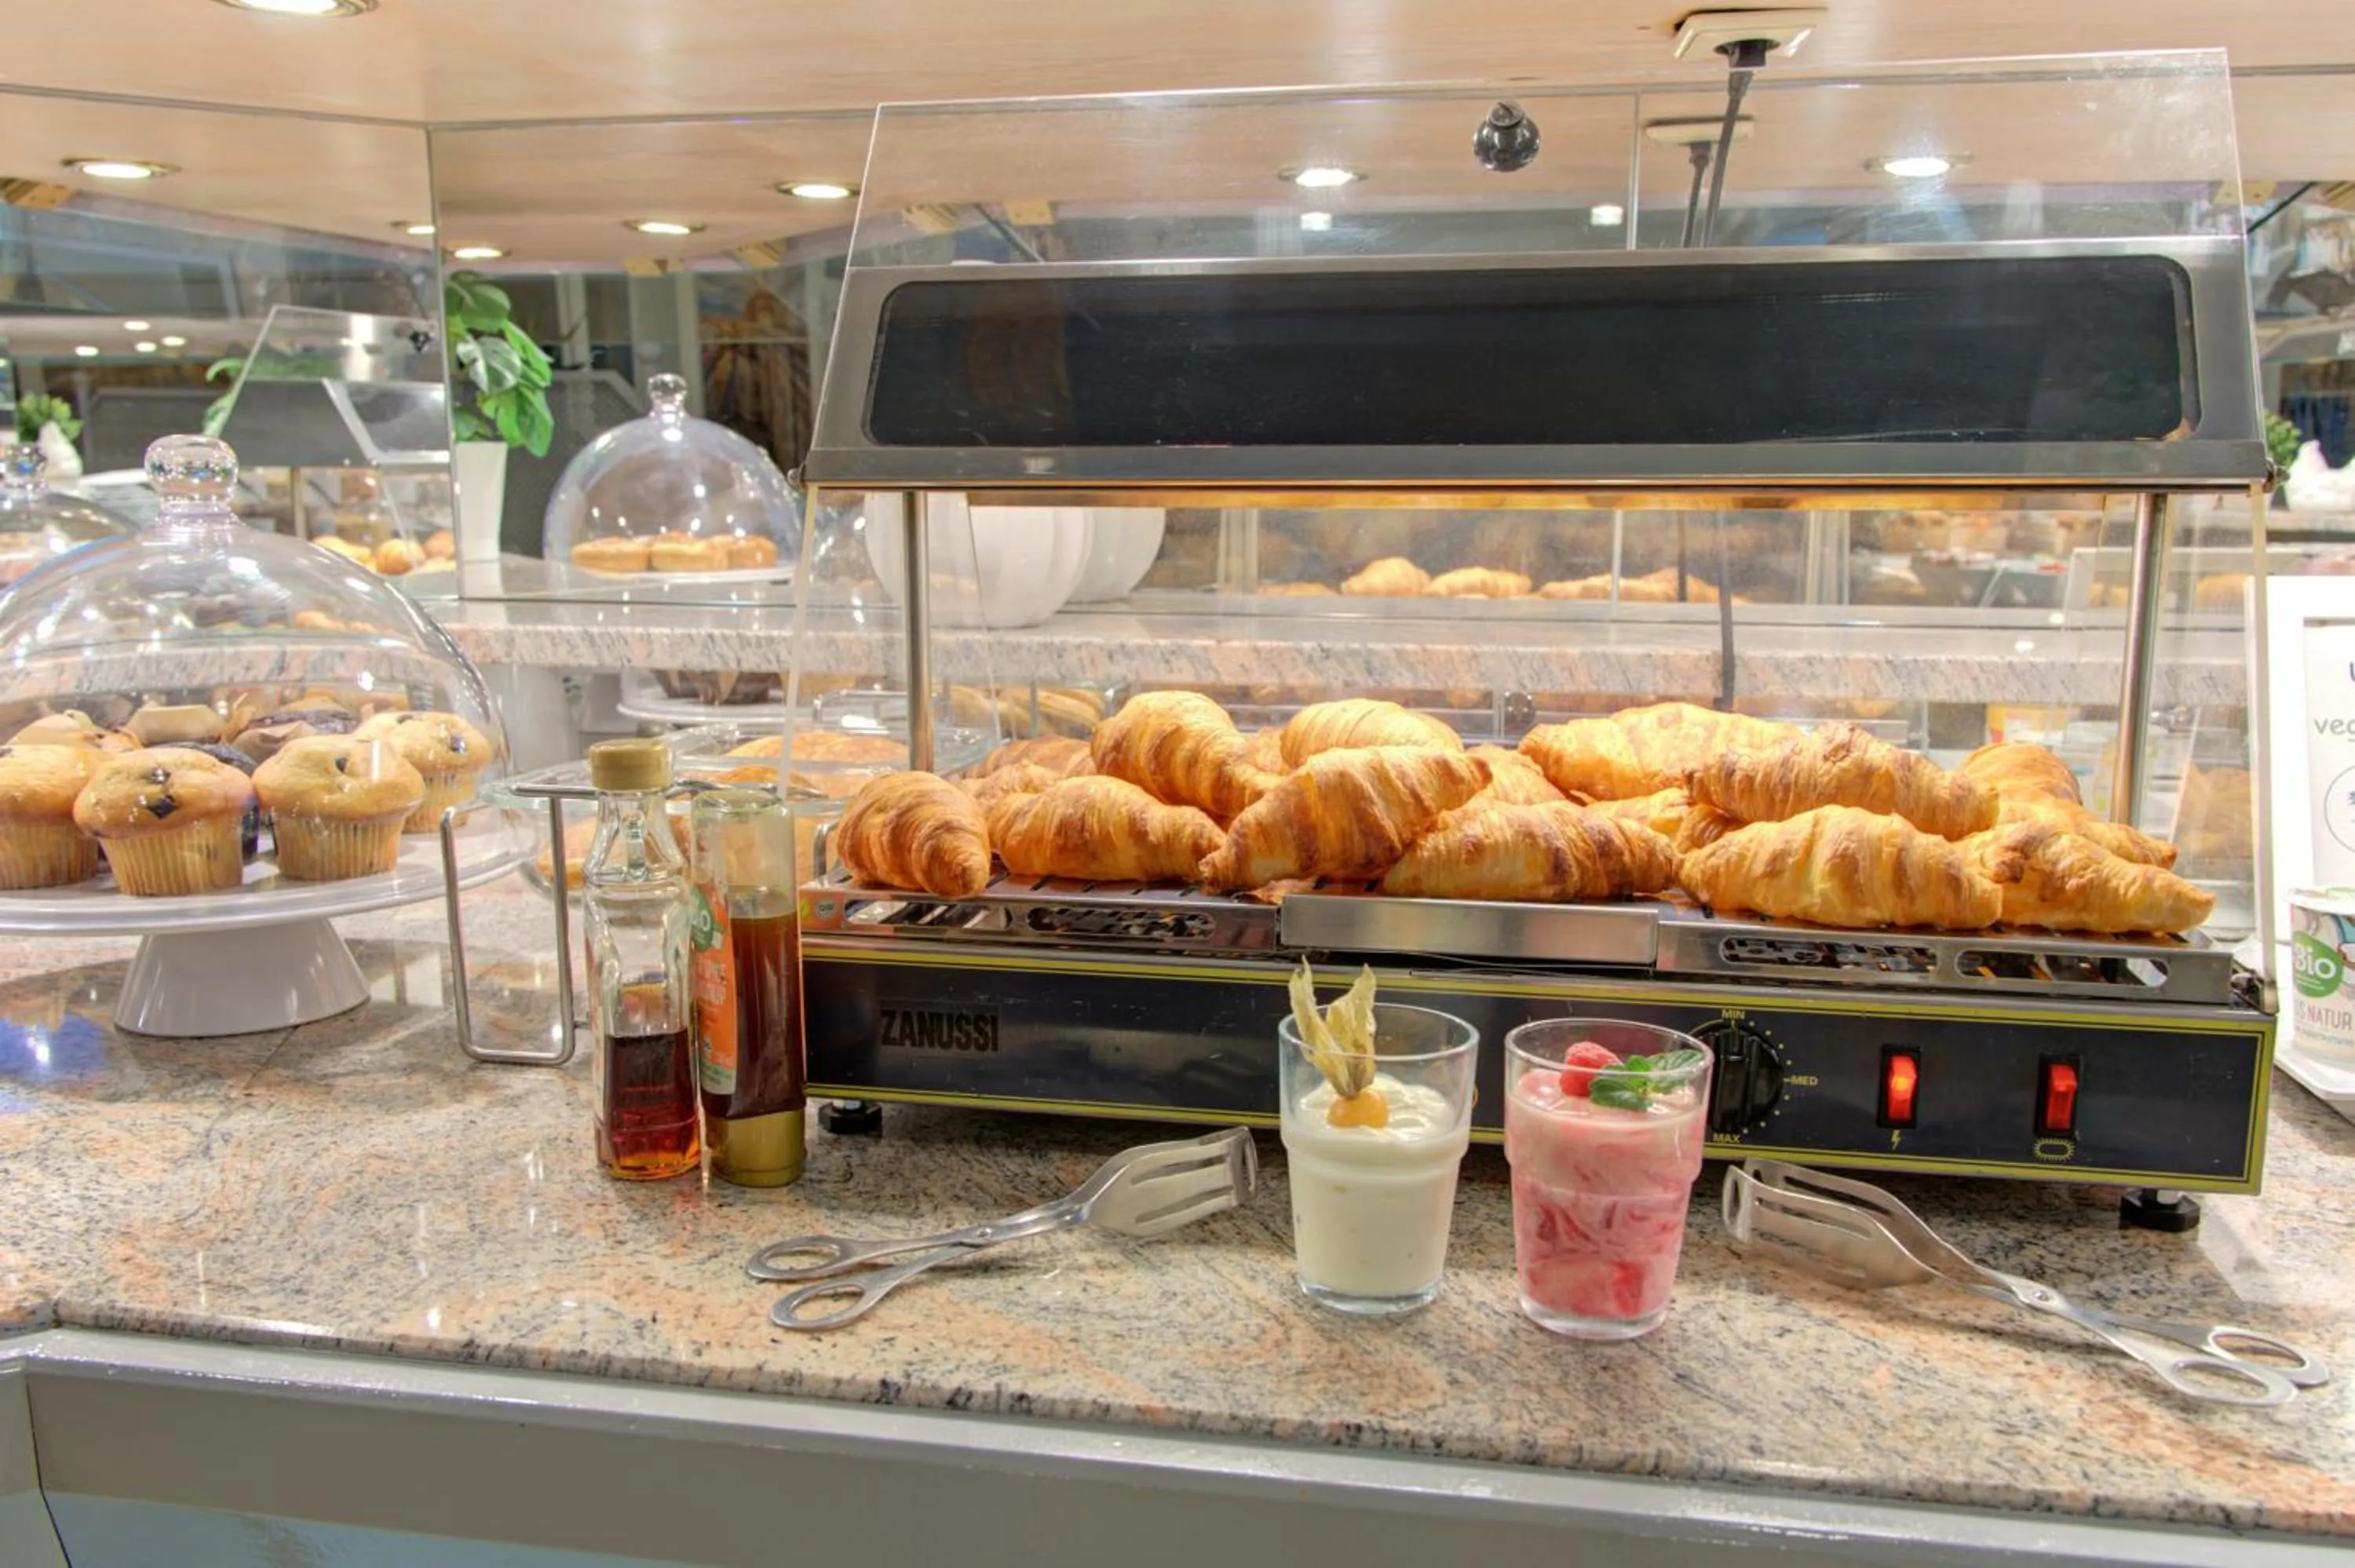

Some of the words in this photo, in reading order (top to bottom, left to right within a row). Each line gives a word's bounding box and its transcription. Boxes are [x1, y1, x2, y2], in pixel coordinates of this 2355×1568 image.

[1722, 1008, 1745, 1019] MIN
[2306, 1004, 2352, 1030] NATUR
[880, 1008, 999, 1052] ZANUSSI
[1791, 1075, 1818, 1086] MED
[1713, 1132, 1740, 1143] MAX
